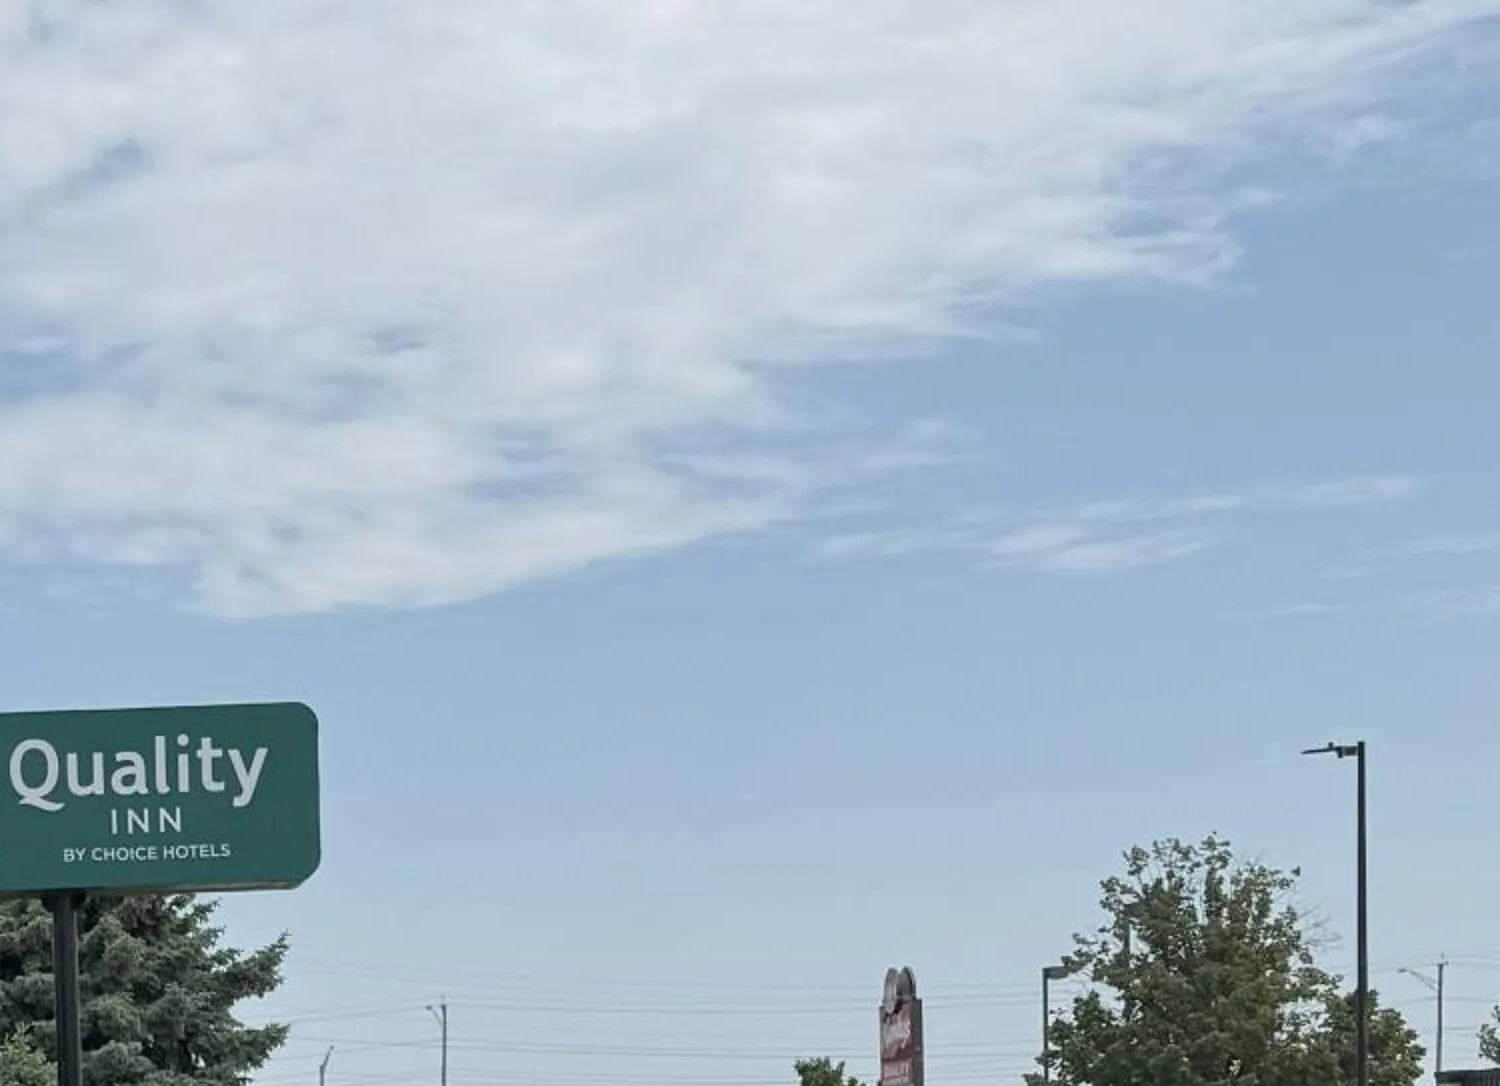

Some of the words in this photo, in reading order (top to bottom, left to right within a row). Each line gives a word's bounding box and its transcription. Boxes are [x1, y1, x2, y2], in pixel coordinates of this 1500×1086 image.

[9, 733, 269, 812] Quality
[110, 806, 182, 835] INN
[63, 847, 86, 863] BY
[91, 846, 159, 862] CHOICE
[163, 843, 232, 860] HOTELS
